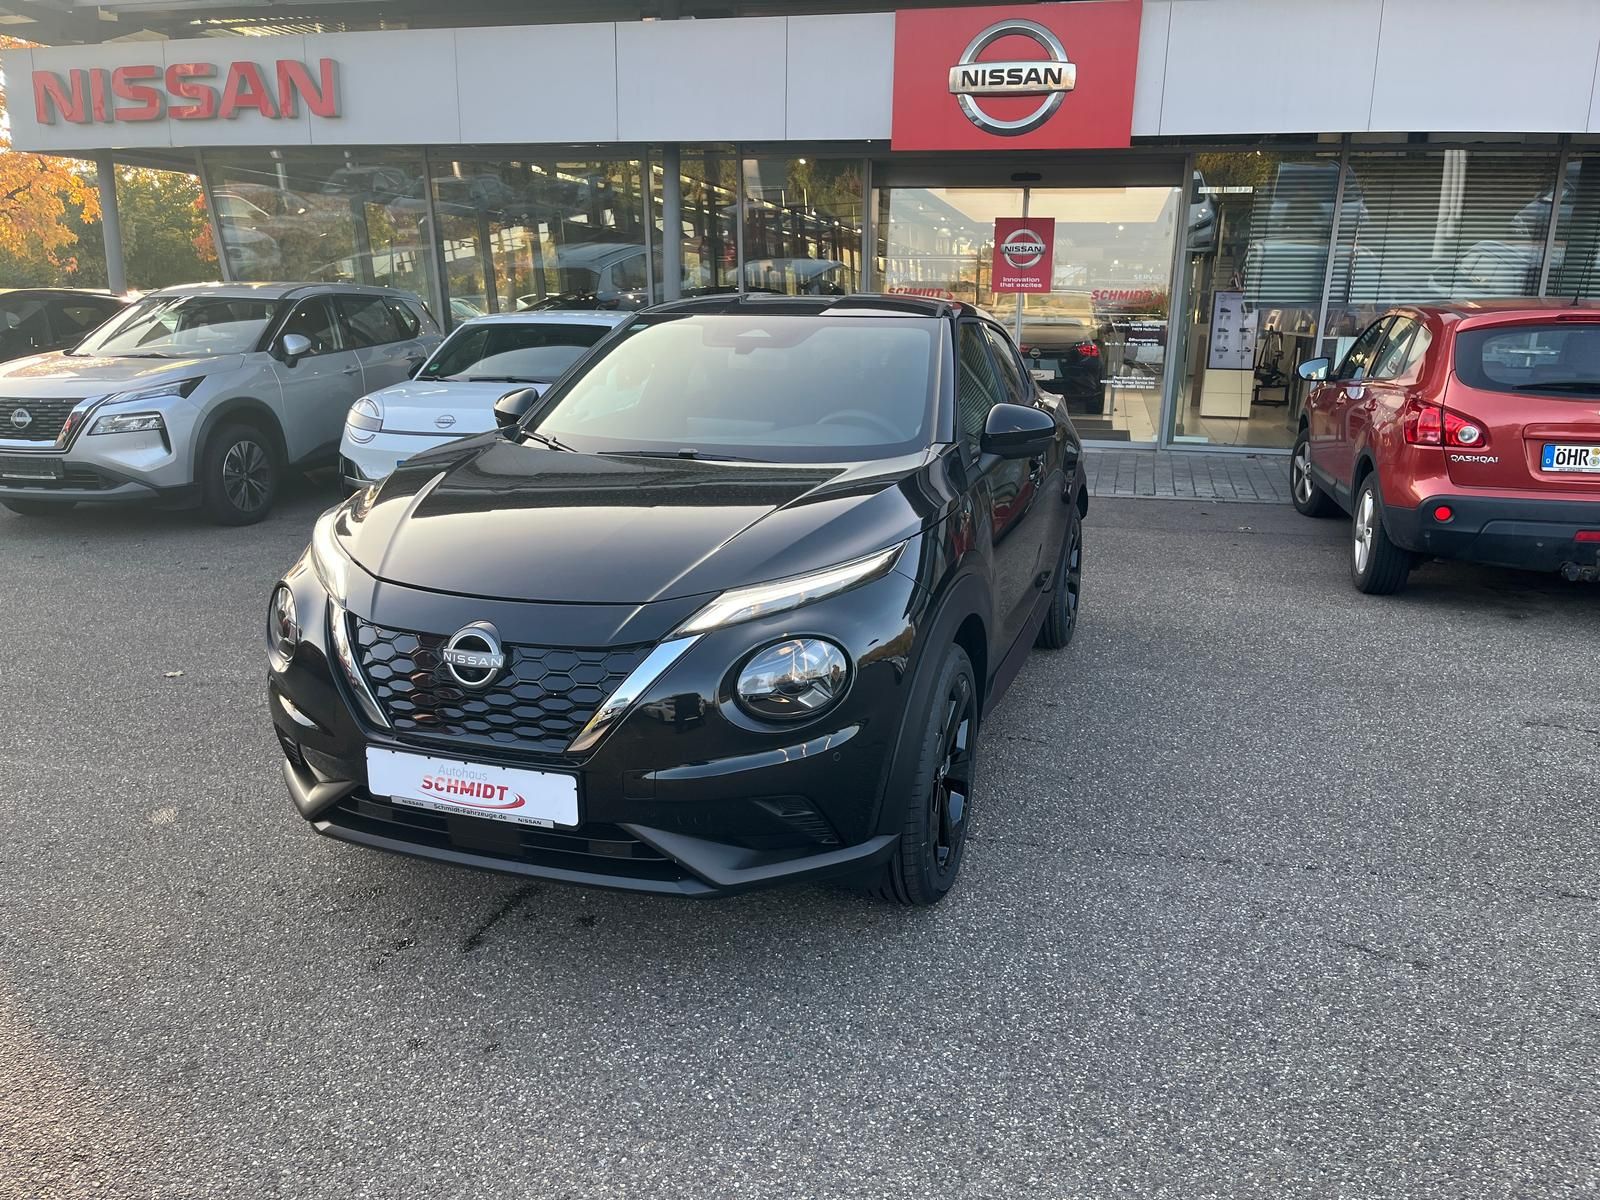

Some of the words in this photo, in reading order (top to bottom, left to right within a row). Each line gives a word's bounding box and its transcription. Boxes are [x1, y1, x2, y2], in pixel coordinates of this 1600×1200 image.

[961, 67, 1063, 88] NISSAN
[32, 58, 341, 124] NISSAN
[1091, 289, 1153, 301] SCHMIDT
[1450, 454, 1499, 464] QASHQAI
[1555, 448, 1590, 466] ÖHR
[443, 651, 502, 667] NISSAN
[438, 764, 488, 781] Autohaus
[421, 775, 508, 800] SCHMIDT
[401, 799, 424, 807] NISSAN
[433, 803, 507, 820] Schmidt-Fahrzeuge.de
[517, 817, 542, 826] NISSAN
